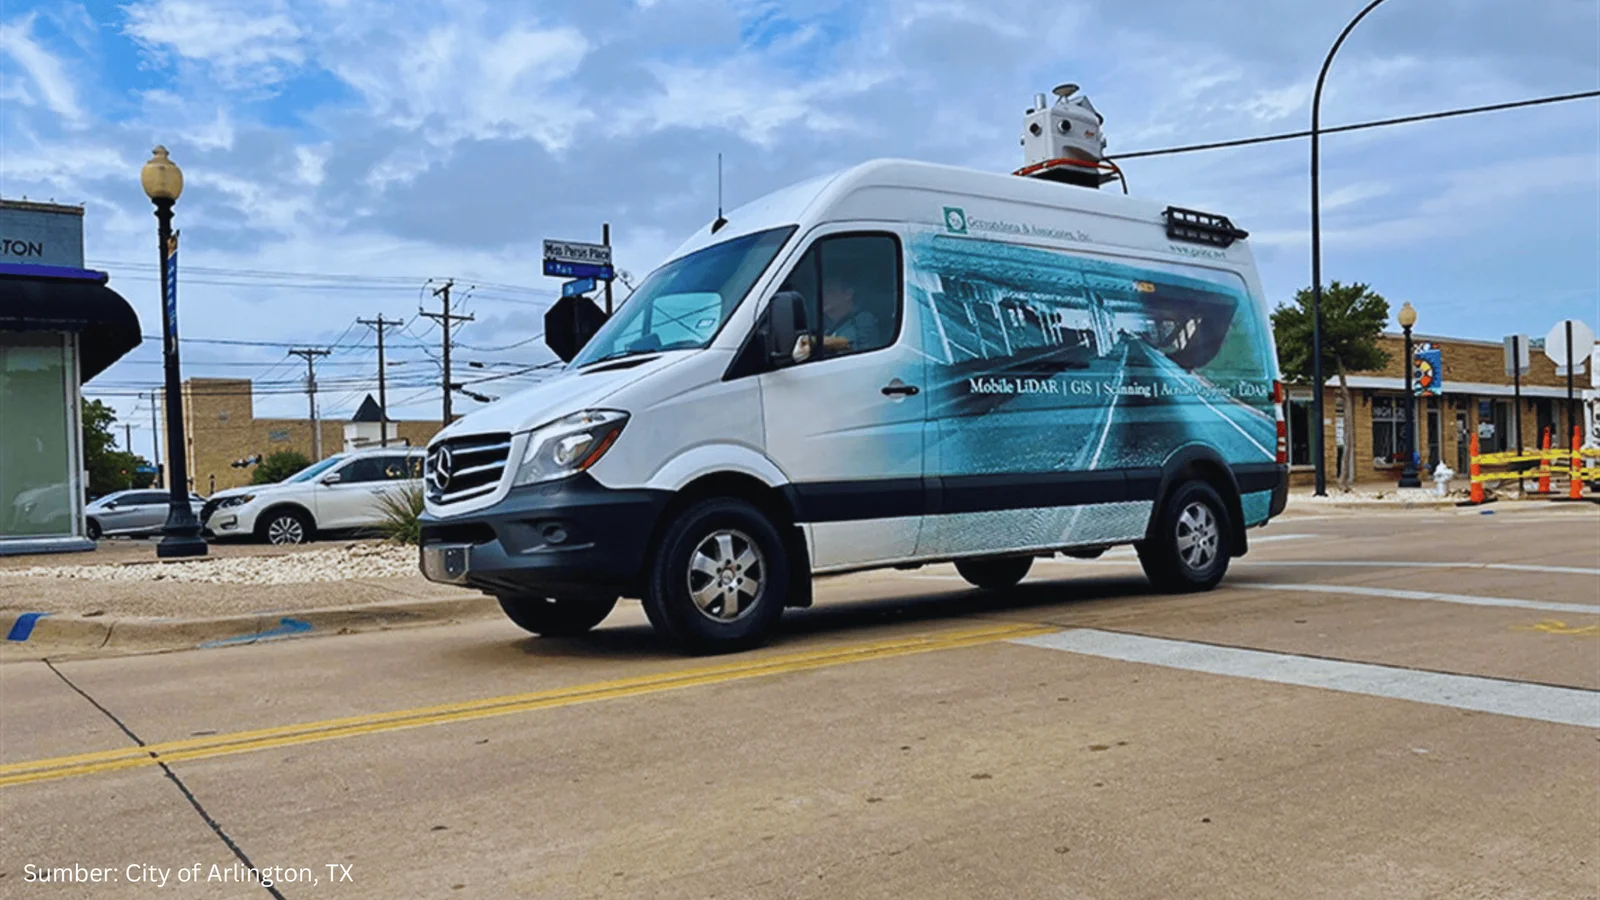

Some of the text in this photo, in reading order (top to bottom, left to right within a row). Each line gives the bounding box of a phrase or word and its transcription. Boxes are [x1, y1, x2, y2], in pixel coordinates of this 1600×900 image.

[0, 239, 43, 257] TON
[969, 378, 1014, 393] Mobile
[1016, 379, 1059, 394] LiDAR
[1071, 380, 1092, 394] GIS
[1103, 381, 1151, 397] Scanning
